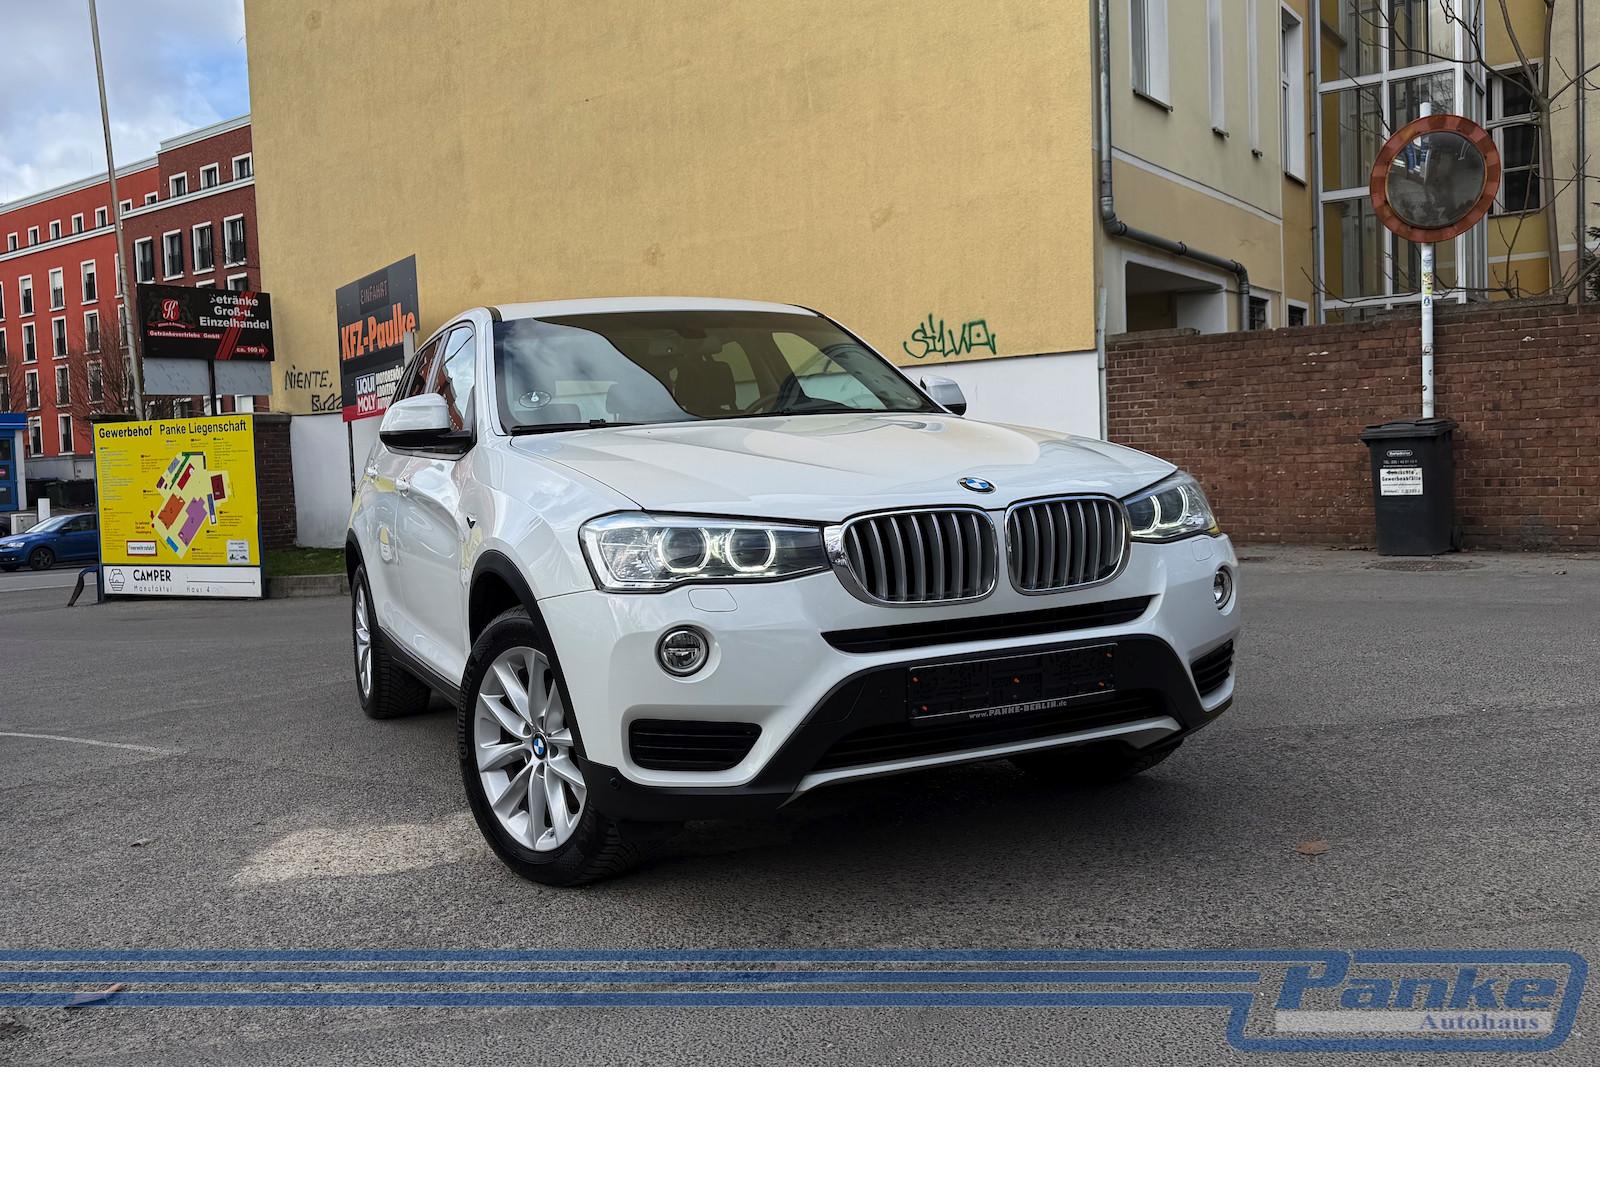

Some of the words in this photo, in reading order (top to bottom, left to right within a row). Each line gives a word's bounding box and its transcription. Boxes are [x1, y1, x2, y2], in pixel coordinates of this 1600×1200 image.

[360, 280, 388, 305] EINFAHRT
[199, 316, 270, 329] Einzelhandel
[341, 303, 416, 360] KFZ-Paulke
[356, 375, 375, 395] LIQUI
[357, 394, 377, 413] MOLY
[98, 424, 153, 439] Gewerbehof
[159, 423, 186, 435] Panke
[188, 420, 247, 436] Liegenschaft
[133, 569, 172, 582] CAMPER
